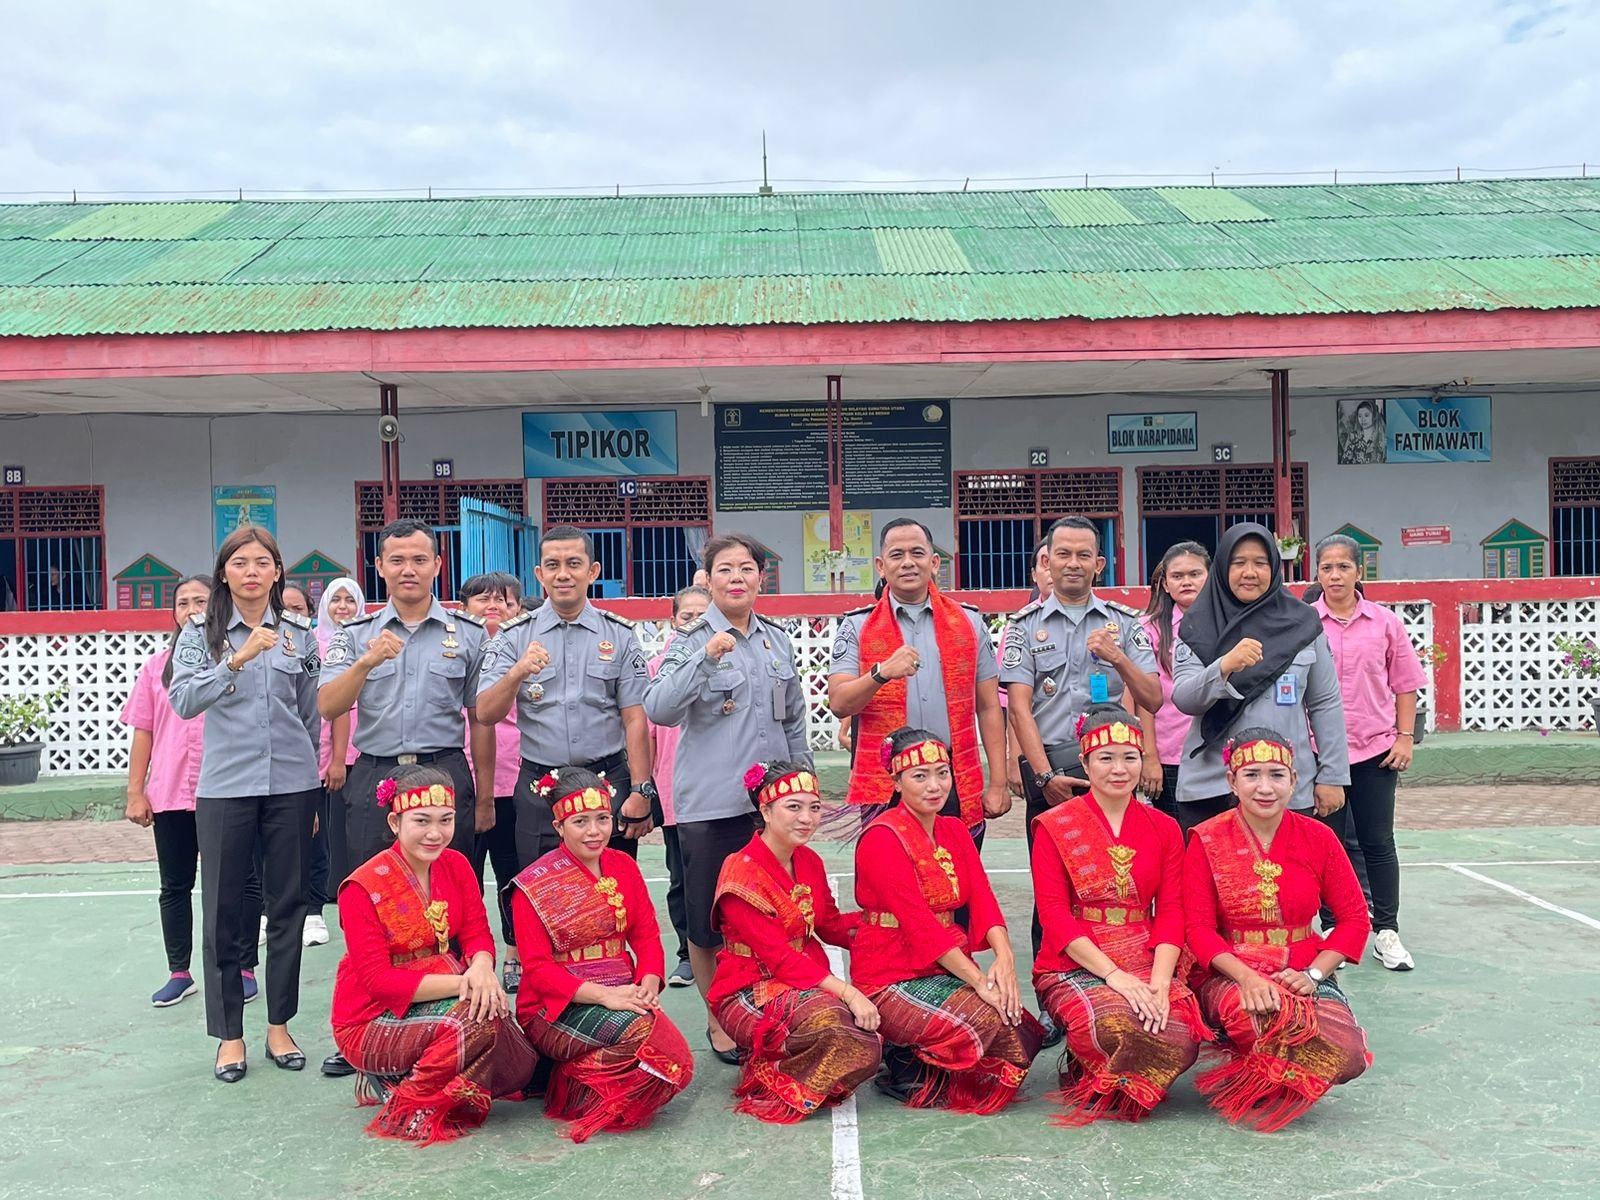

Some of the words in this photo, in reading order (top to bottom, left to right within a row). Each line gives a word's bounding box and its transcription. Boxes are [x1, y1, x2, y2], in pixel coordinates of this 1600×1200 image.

[1418, 409, 1460, 428] BLOK
[551, 429, 651, 459] TIPIKOR
[1111, 430, 1135, 448] BLOK
[1137, 428, 1195, 447] NARAPIDANA
[1395, 431, 1483, 451] FATMAWATI
[1031, 452, 1047, 465] 2C
[1215, 448, 1231, 461] 3C
[6, 469, 22, 483] 8B
[435, 463, 451, 476] 9B
[620, 482, 635, 494] 1C
